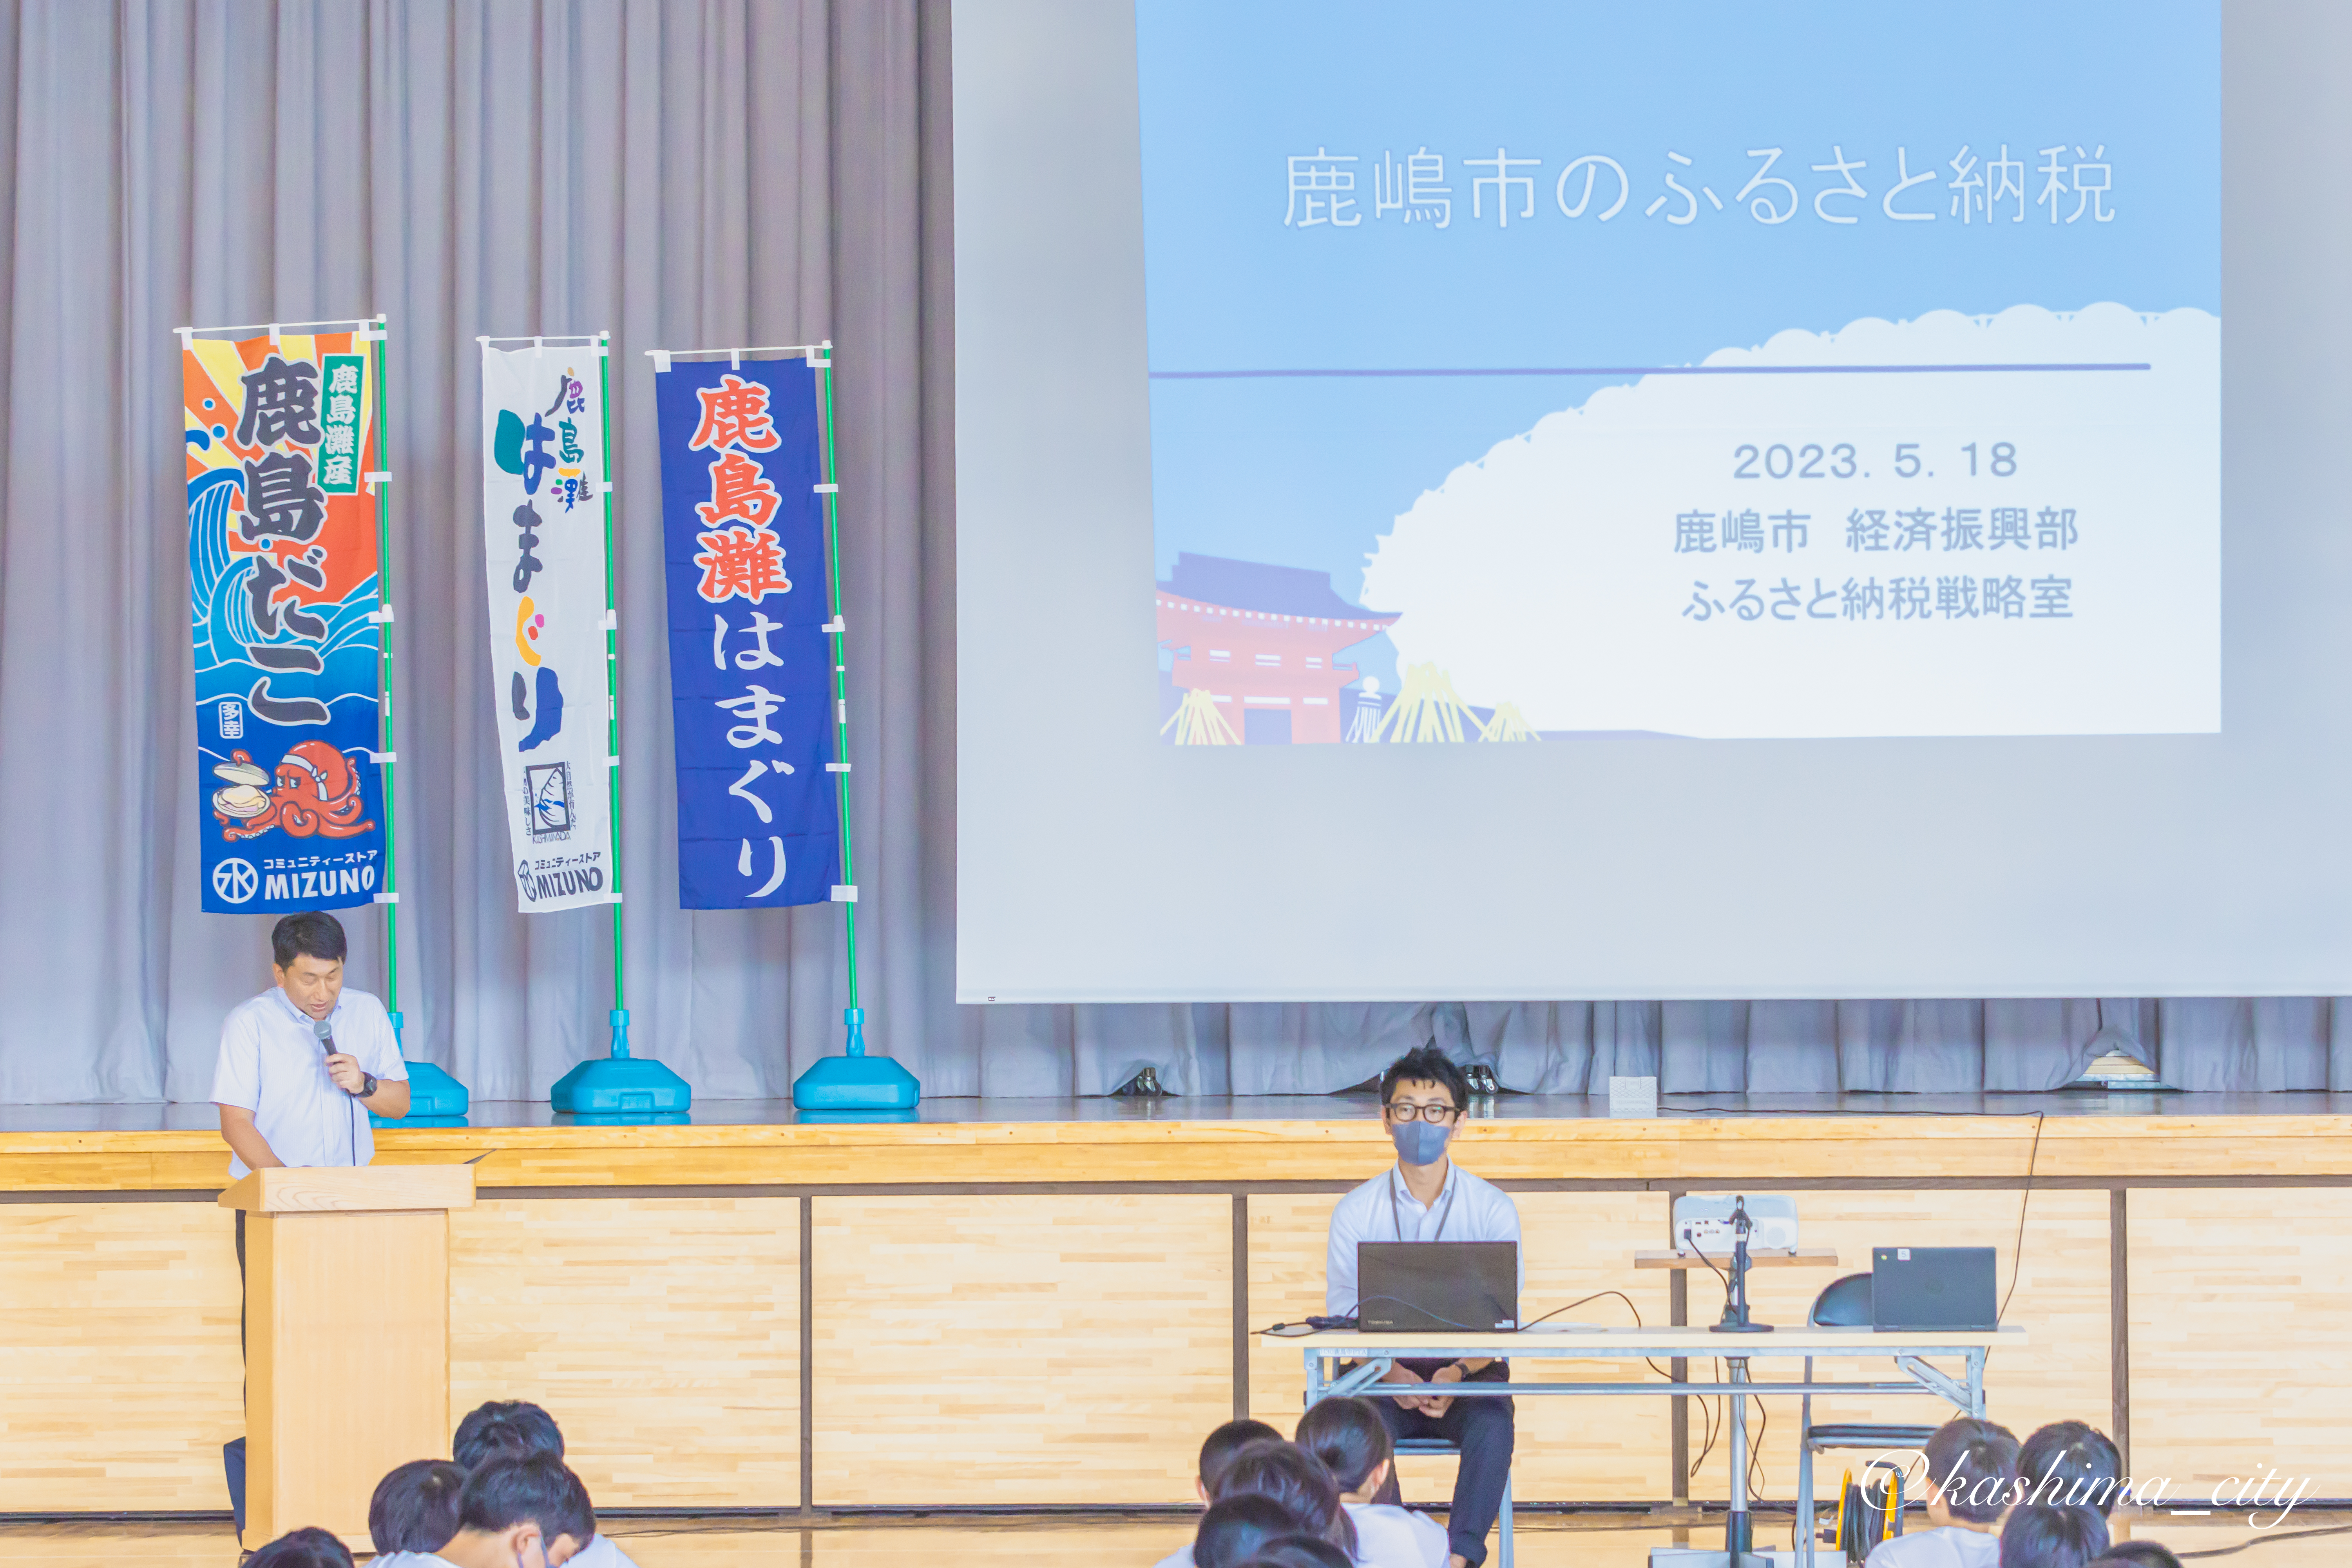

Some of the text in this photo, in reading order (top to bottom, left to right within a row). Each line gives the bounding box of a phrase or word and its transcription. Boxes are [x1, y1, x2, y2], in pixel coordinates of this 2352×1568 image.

[1284, 144, 2115, 228] 鹿嶋市のふるさと納税
[324, 364, 359, 485] 鹿島灘産
[545, 367, 593, 513] 鹿島灘
[234, 353, 331, 726] 鹿島だこ
[1674, 505, 2079, 554] 鹿嶋市 経済振興部
[494, 409, 563, 752] はまぐり
[1682, 573, 2074, 622] ふるさと納税戦略室
[264, 850, 377, 869] コミュニティーストア
[265, 865, 375, 900] MIZUNO
[535, 852, 601, 870] コミュニティーストア
[536, 867, 603, 899] MIZUNO
